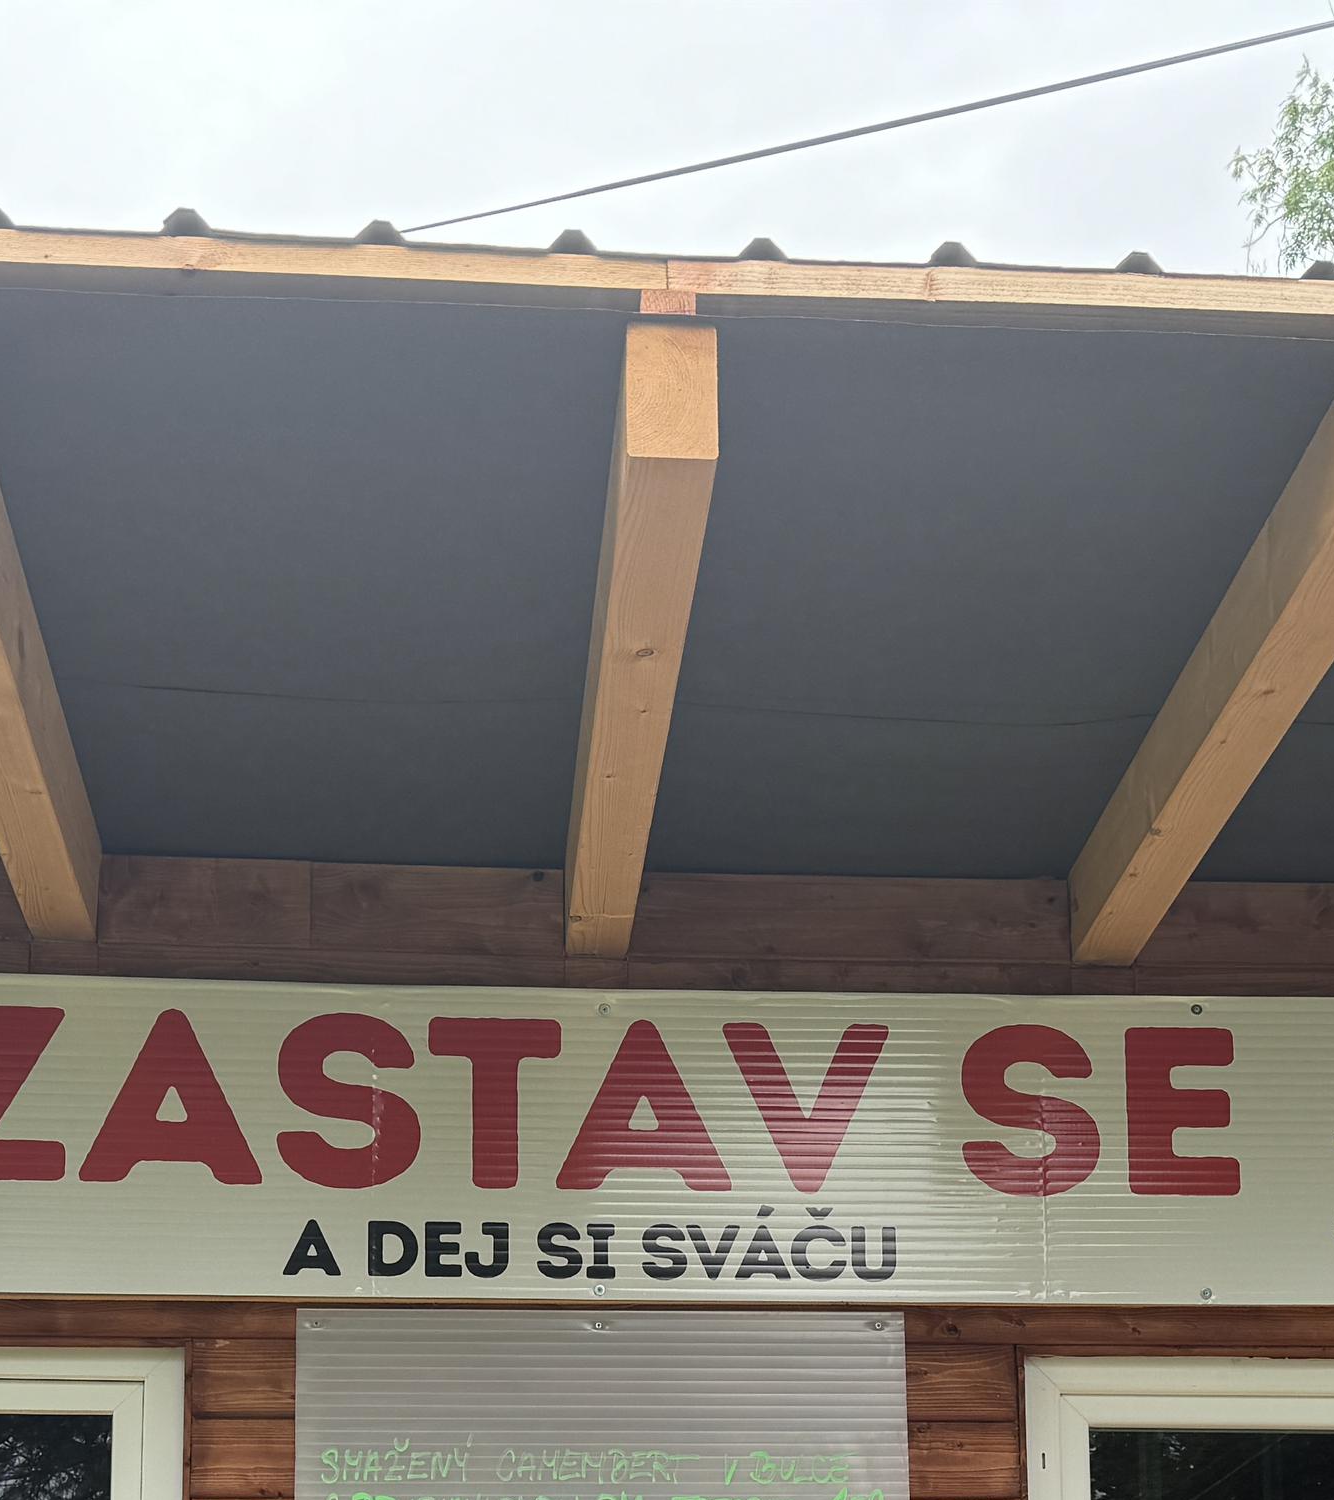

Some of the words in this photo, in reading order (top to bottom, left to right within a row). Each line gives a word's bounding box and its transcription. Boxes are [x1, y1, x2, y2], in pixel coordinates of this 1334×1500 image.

[961, 1024, 1241, 1197] SE
[283, 1220, 341, 1276] A
[368, 1221, 510, 1279] DEJ
[536, 1223, 616, 1280] SI
[642, 1206, 897, 1282] SVÁČU
[321, 1433, 473, 1483] SMAŽENÝ
[496, 1448, 699, 1485] CAMEMBERT
